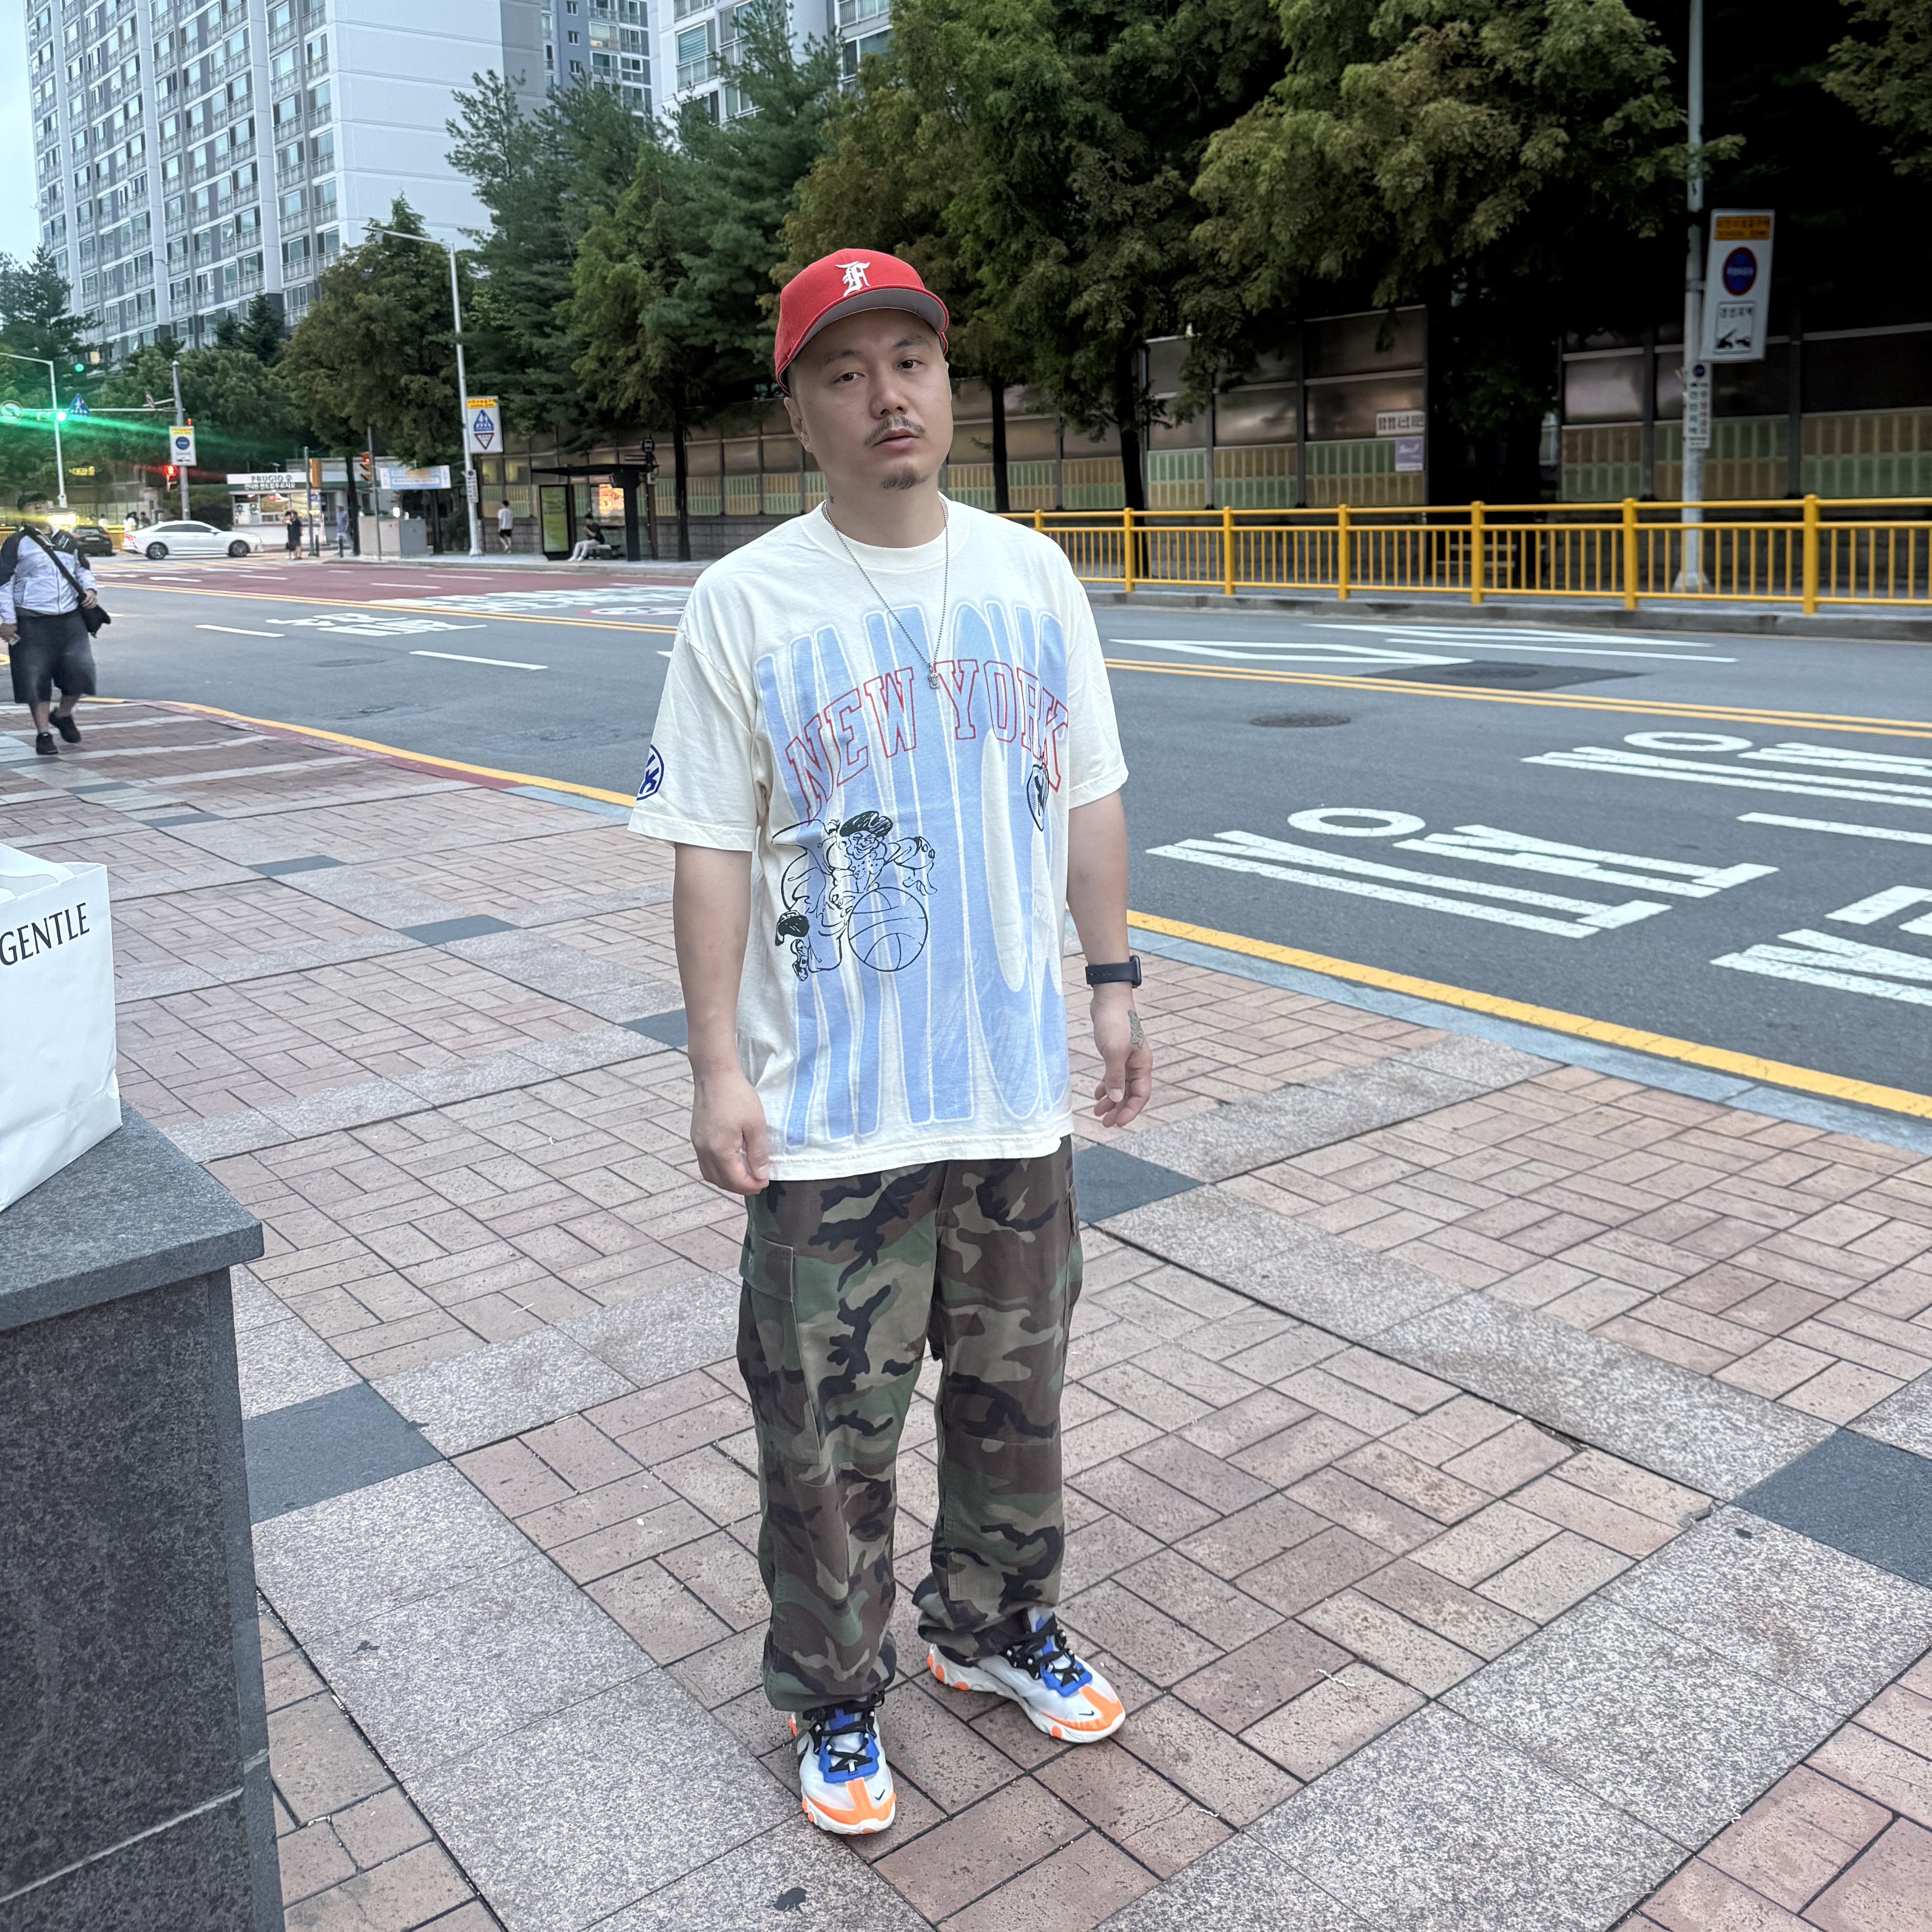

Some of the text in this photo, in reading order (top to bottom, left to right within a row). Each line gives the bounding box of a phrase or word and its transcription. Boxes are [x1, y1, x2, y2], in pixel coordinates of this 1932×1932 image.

[785, 659, 1069, 826] NEW YORK
[0, 902, 90, 966] GENTLE
